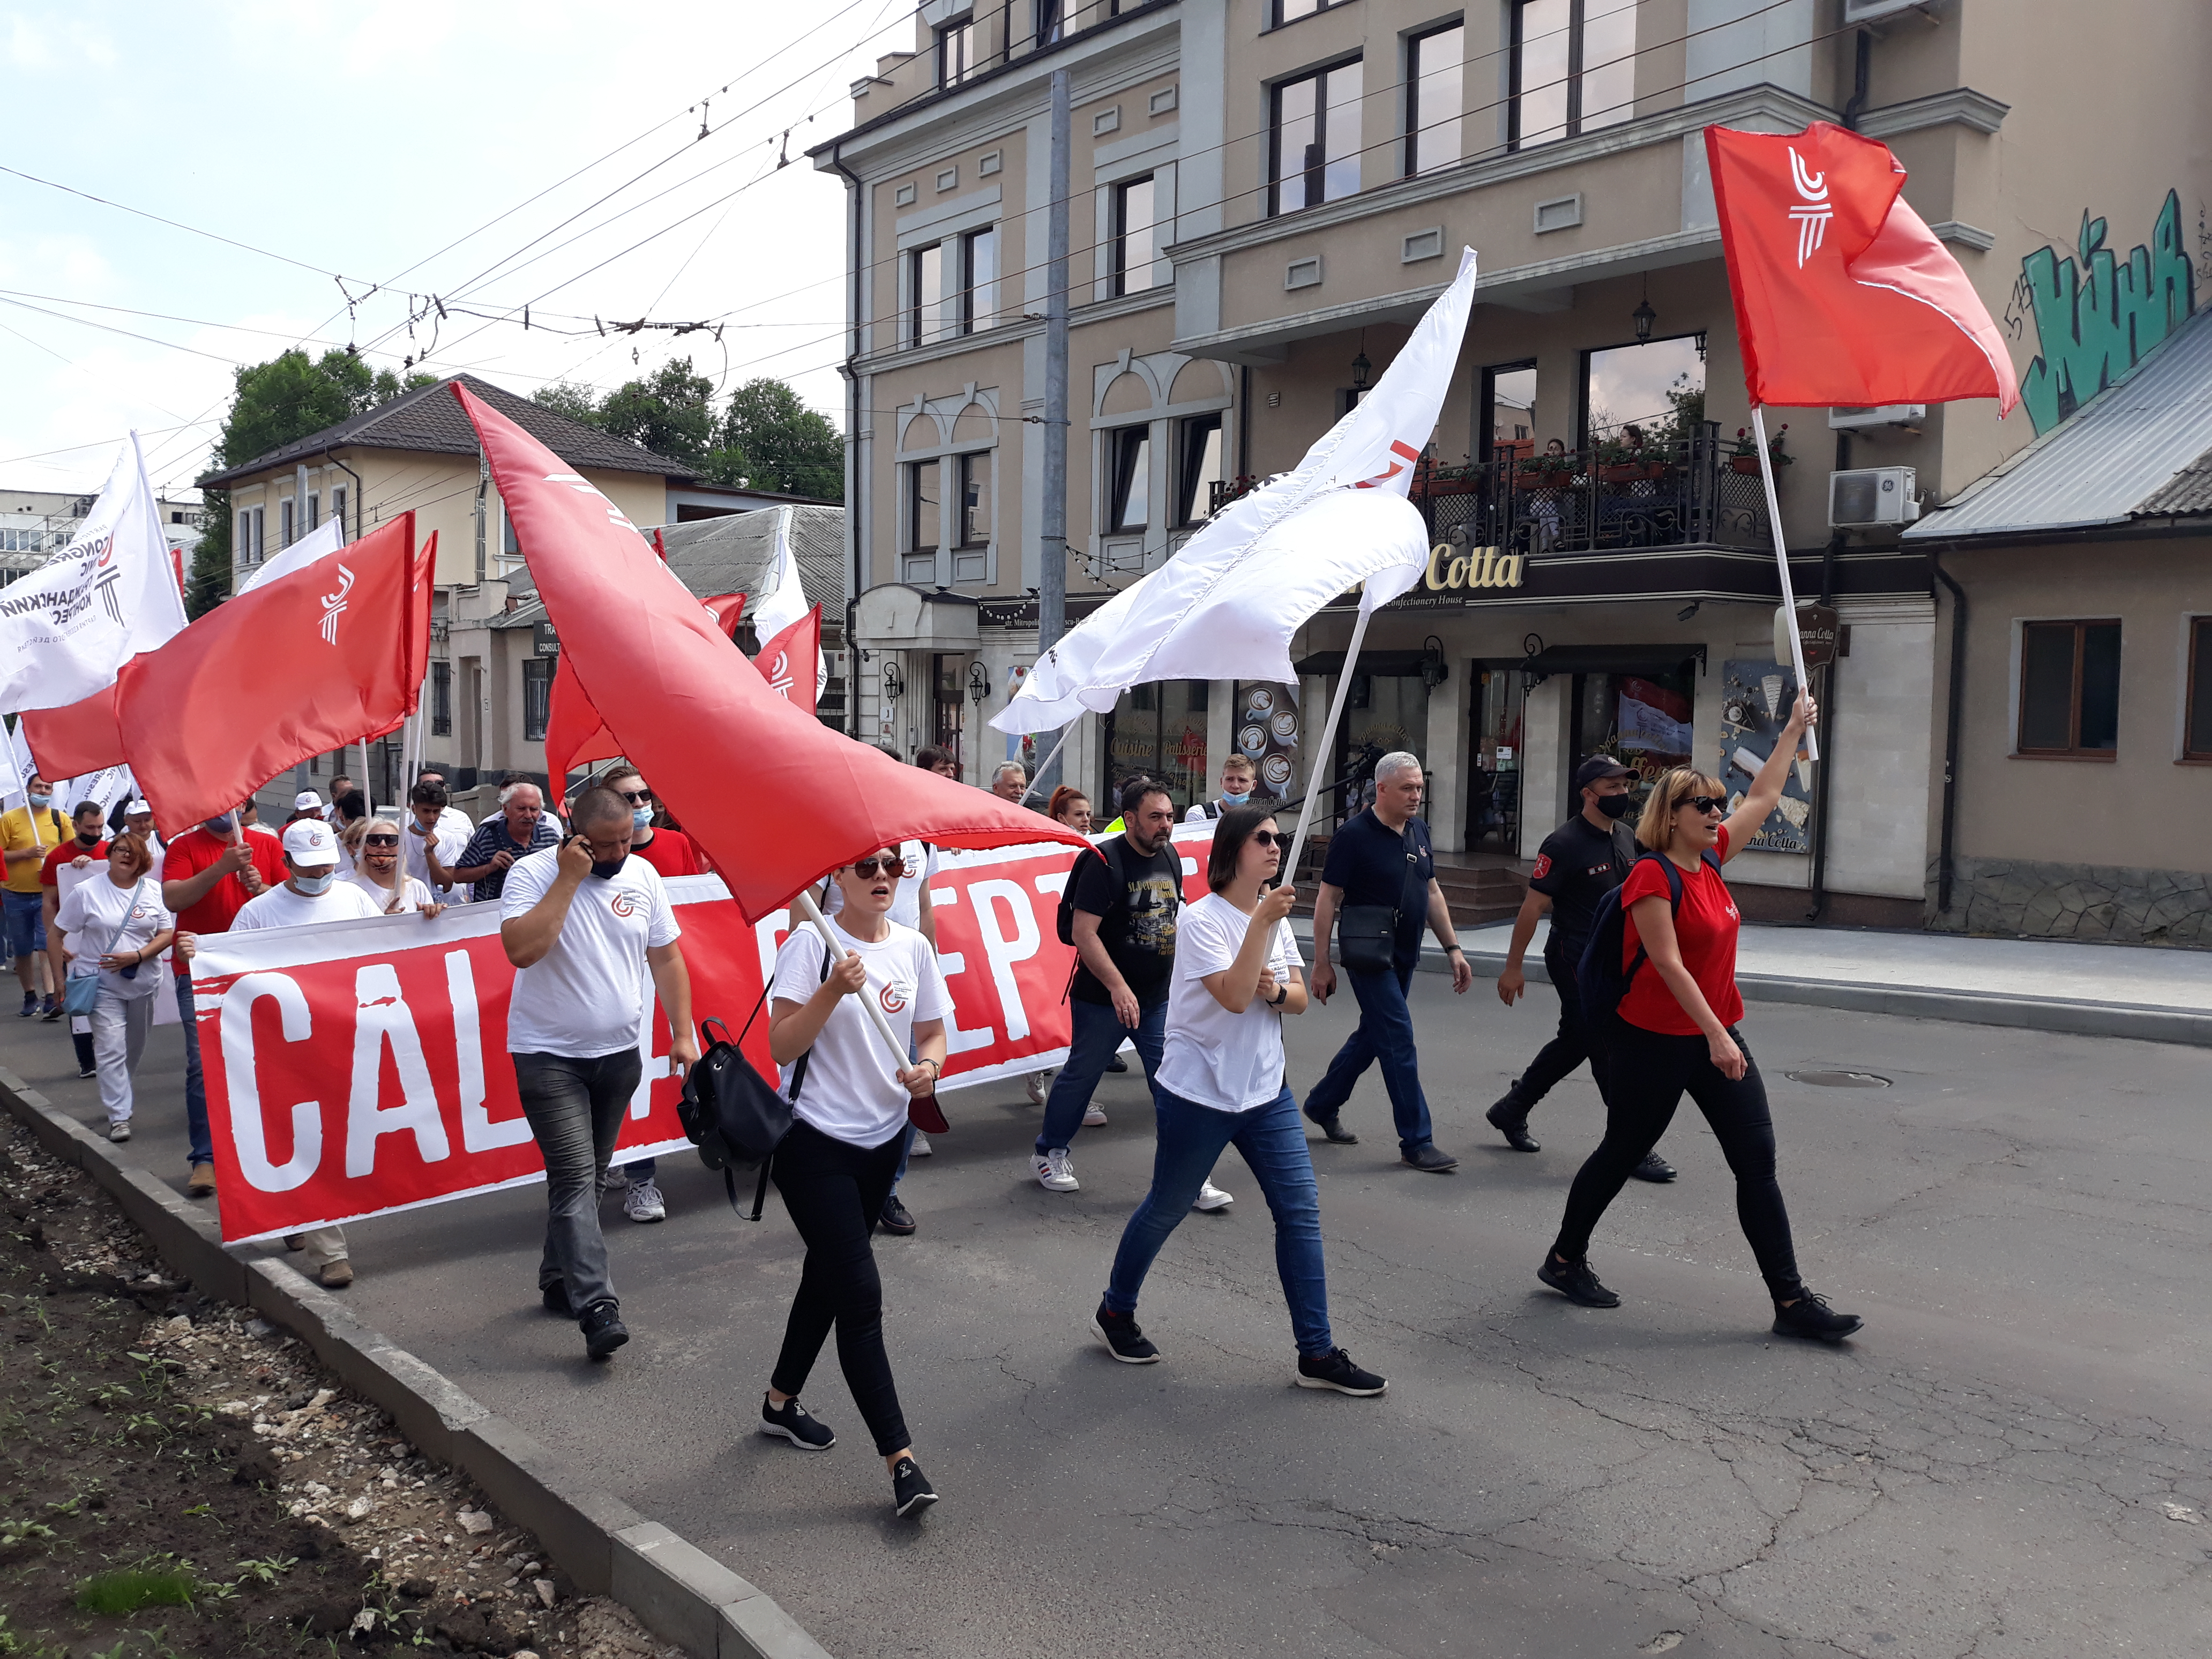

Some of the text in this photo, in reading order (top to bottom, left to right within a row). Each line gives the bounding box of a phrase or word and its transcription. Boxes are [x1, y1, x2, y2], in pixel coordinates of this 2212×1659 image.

[1425, 543, 1523, 591] Cotta
[1439, 594, 1463, 604] House
[543, 623, 556, 635] TRA
[1798, 627, 1817, 639] anna
[539, 642, 561, 652] CONSULT
[1110, 737, 1153, 757] Cuisine
